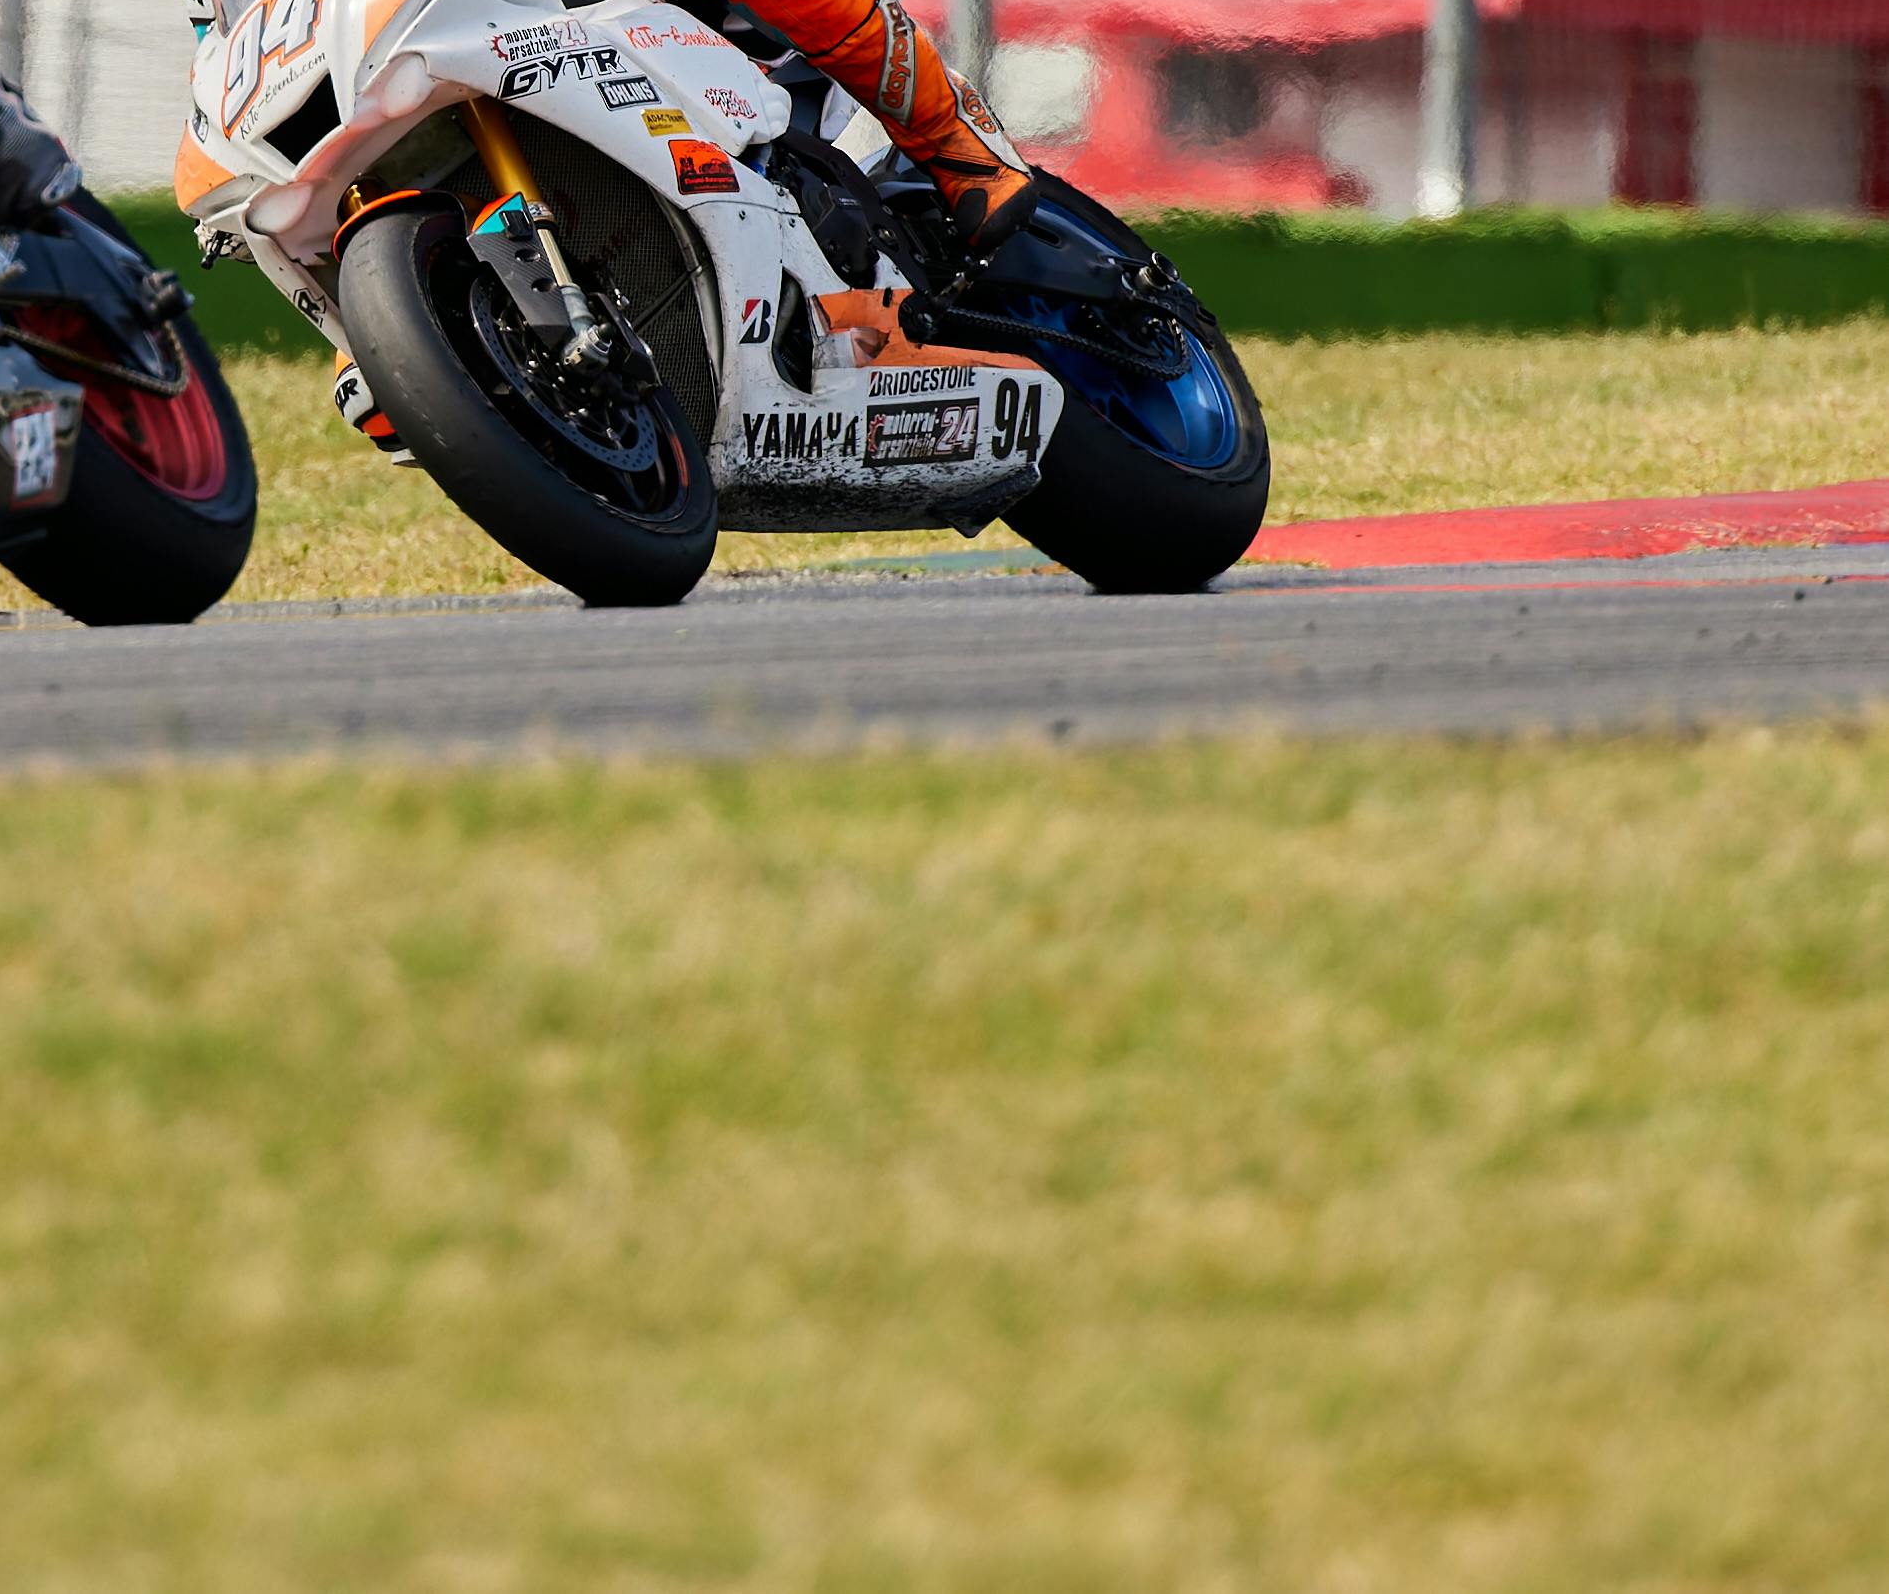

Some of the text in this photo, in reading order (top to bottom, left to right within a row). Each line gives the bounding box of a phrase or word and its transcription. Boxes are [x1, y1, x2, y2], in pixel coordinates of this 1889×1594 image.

[508, 37, 560, 61] ersatzteile
[553, 19, 588, 47] 24
[497, 45, 628, 101] GYTR
[601, 81, 656, 106] ÖHLINS
[869, 366, 976, 398] BRIDGESTONE
[933, 405, 979, 455] 24
[992, 378, 1042, 463] 94
